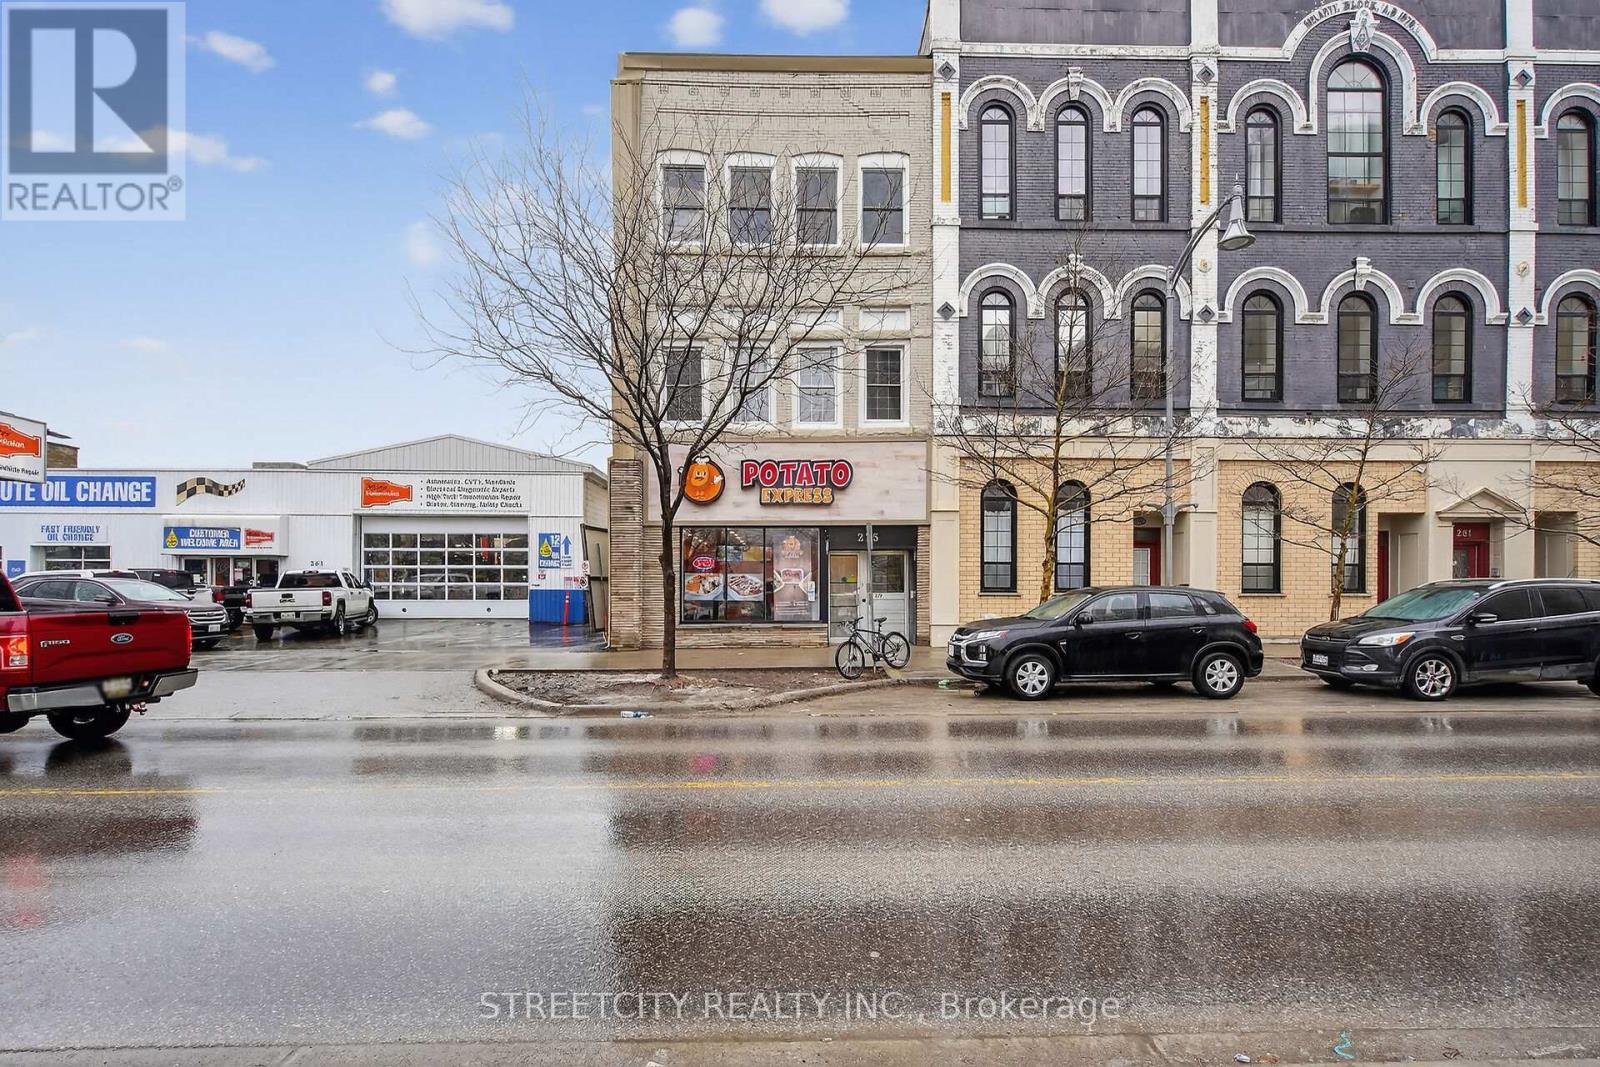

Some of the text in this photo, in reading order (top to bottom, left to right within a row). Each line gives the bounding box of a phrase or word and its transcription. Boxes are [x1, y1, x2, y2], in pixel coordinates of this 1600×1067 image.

[742, 460, 853, 488] POTATO
[42, 481, 70, 501] OIL
[76, 481, 152, 502] CHANGE
[760, 488, 833, 504] EXPRESS
[41, 525, 60, 533] FAST
[857, 532, 879, 542] 25
